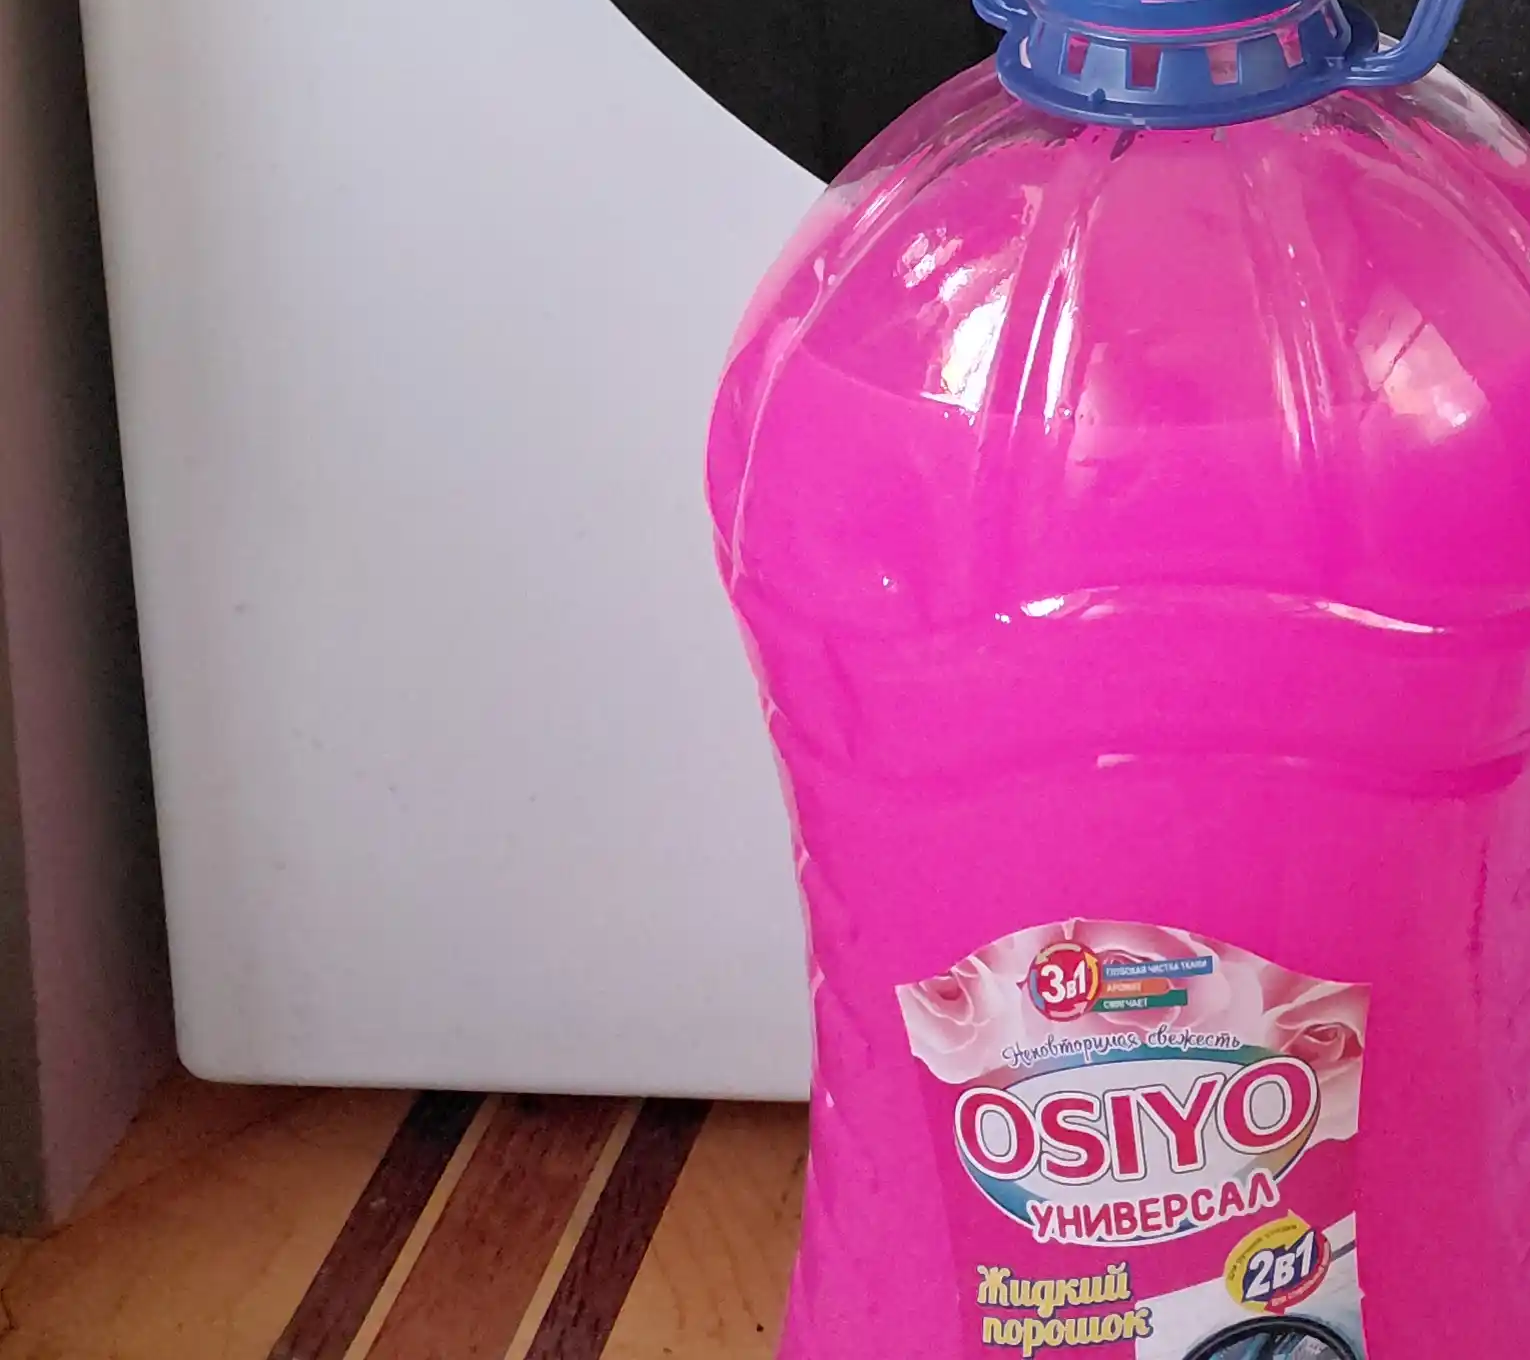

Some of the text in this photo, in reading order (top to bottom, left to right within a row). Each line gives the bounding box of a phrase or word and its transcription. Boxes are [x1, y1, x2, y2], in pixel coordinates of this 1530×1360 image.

[1147, 1024, 1241, 1049] свежесть
[955, 1056, 1319, 1184] OSIYO
[1029, 1170, 1277, 1242] УНИВЕРСАЛ
[976, 1261, 1133, 1319] Жидкий
[981, 1308, 1155, 1360] порошок
